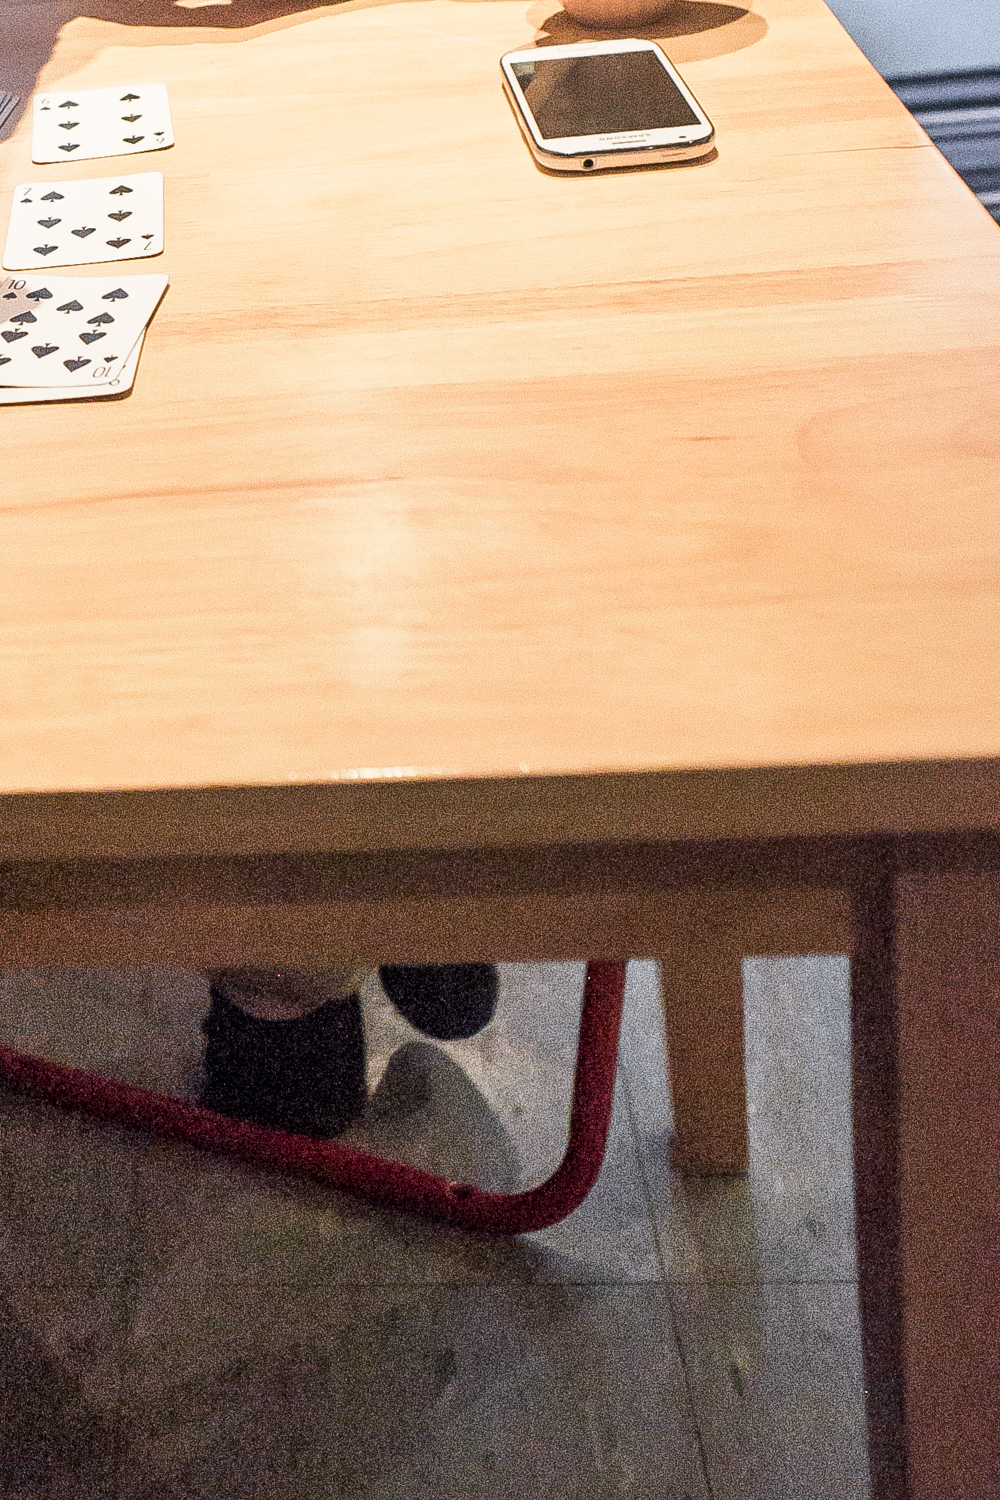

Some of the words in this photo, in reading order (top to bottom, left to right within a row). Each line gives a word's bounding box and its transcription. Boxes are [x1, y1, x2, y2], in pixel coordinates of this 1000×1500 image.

[23, 187, 32, 196] 7
[7, 279, 27, 291] 10
[92, 366, 112, 379] 10
